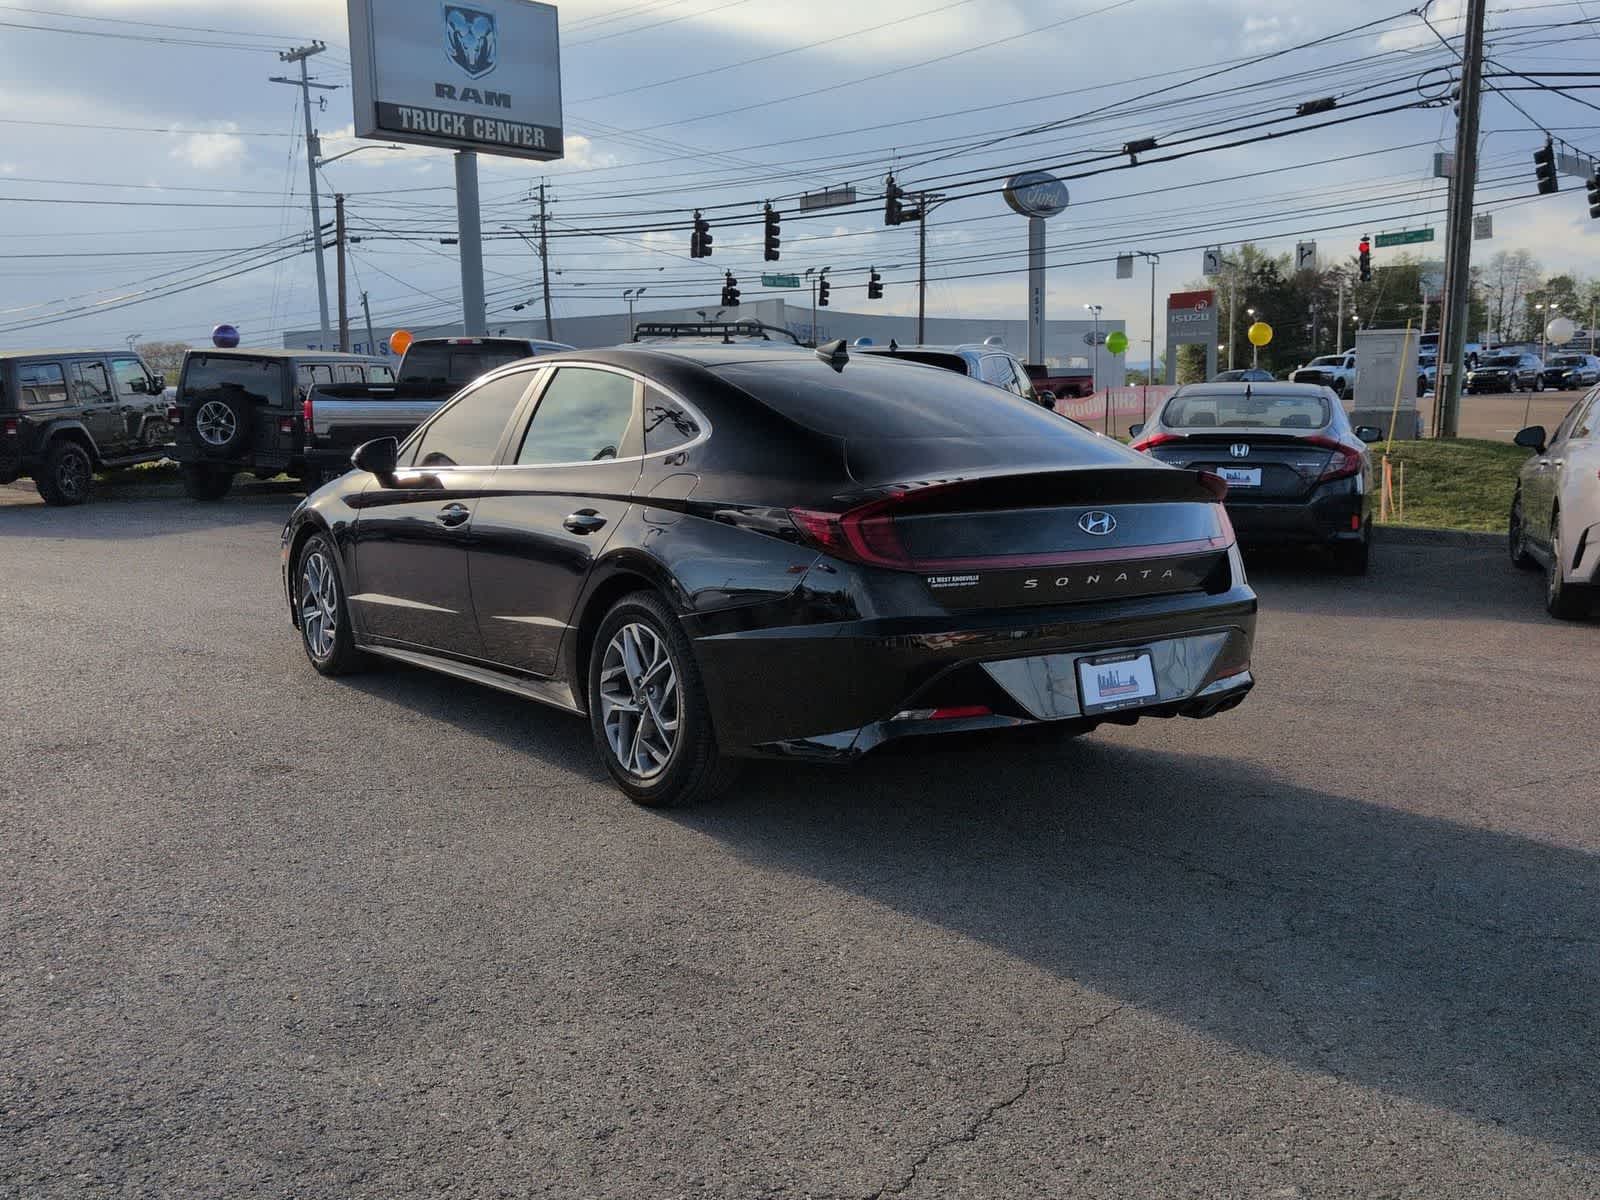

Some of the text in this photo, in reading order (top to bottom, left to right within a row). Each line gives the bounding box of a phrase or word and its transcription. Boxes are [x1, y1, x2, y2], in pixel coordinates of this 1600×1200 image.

[435, 82, 512, 109] RAM
[398, 106, 546, 148] TRUCK CENTER
[1024, 184, 1058, 206] Ford
[1171, 313, 1209, 323] ISUZU
[1023, 569, 1173, 588] SONATA
